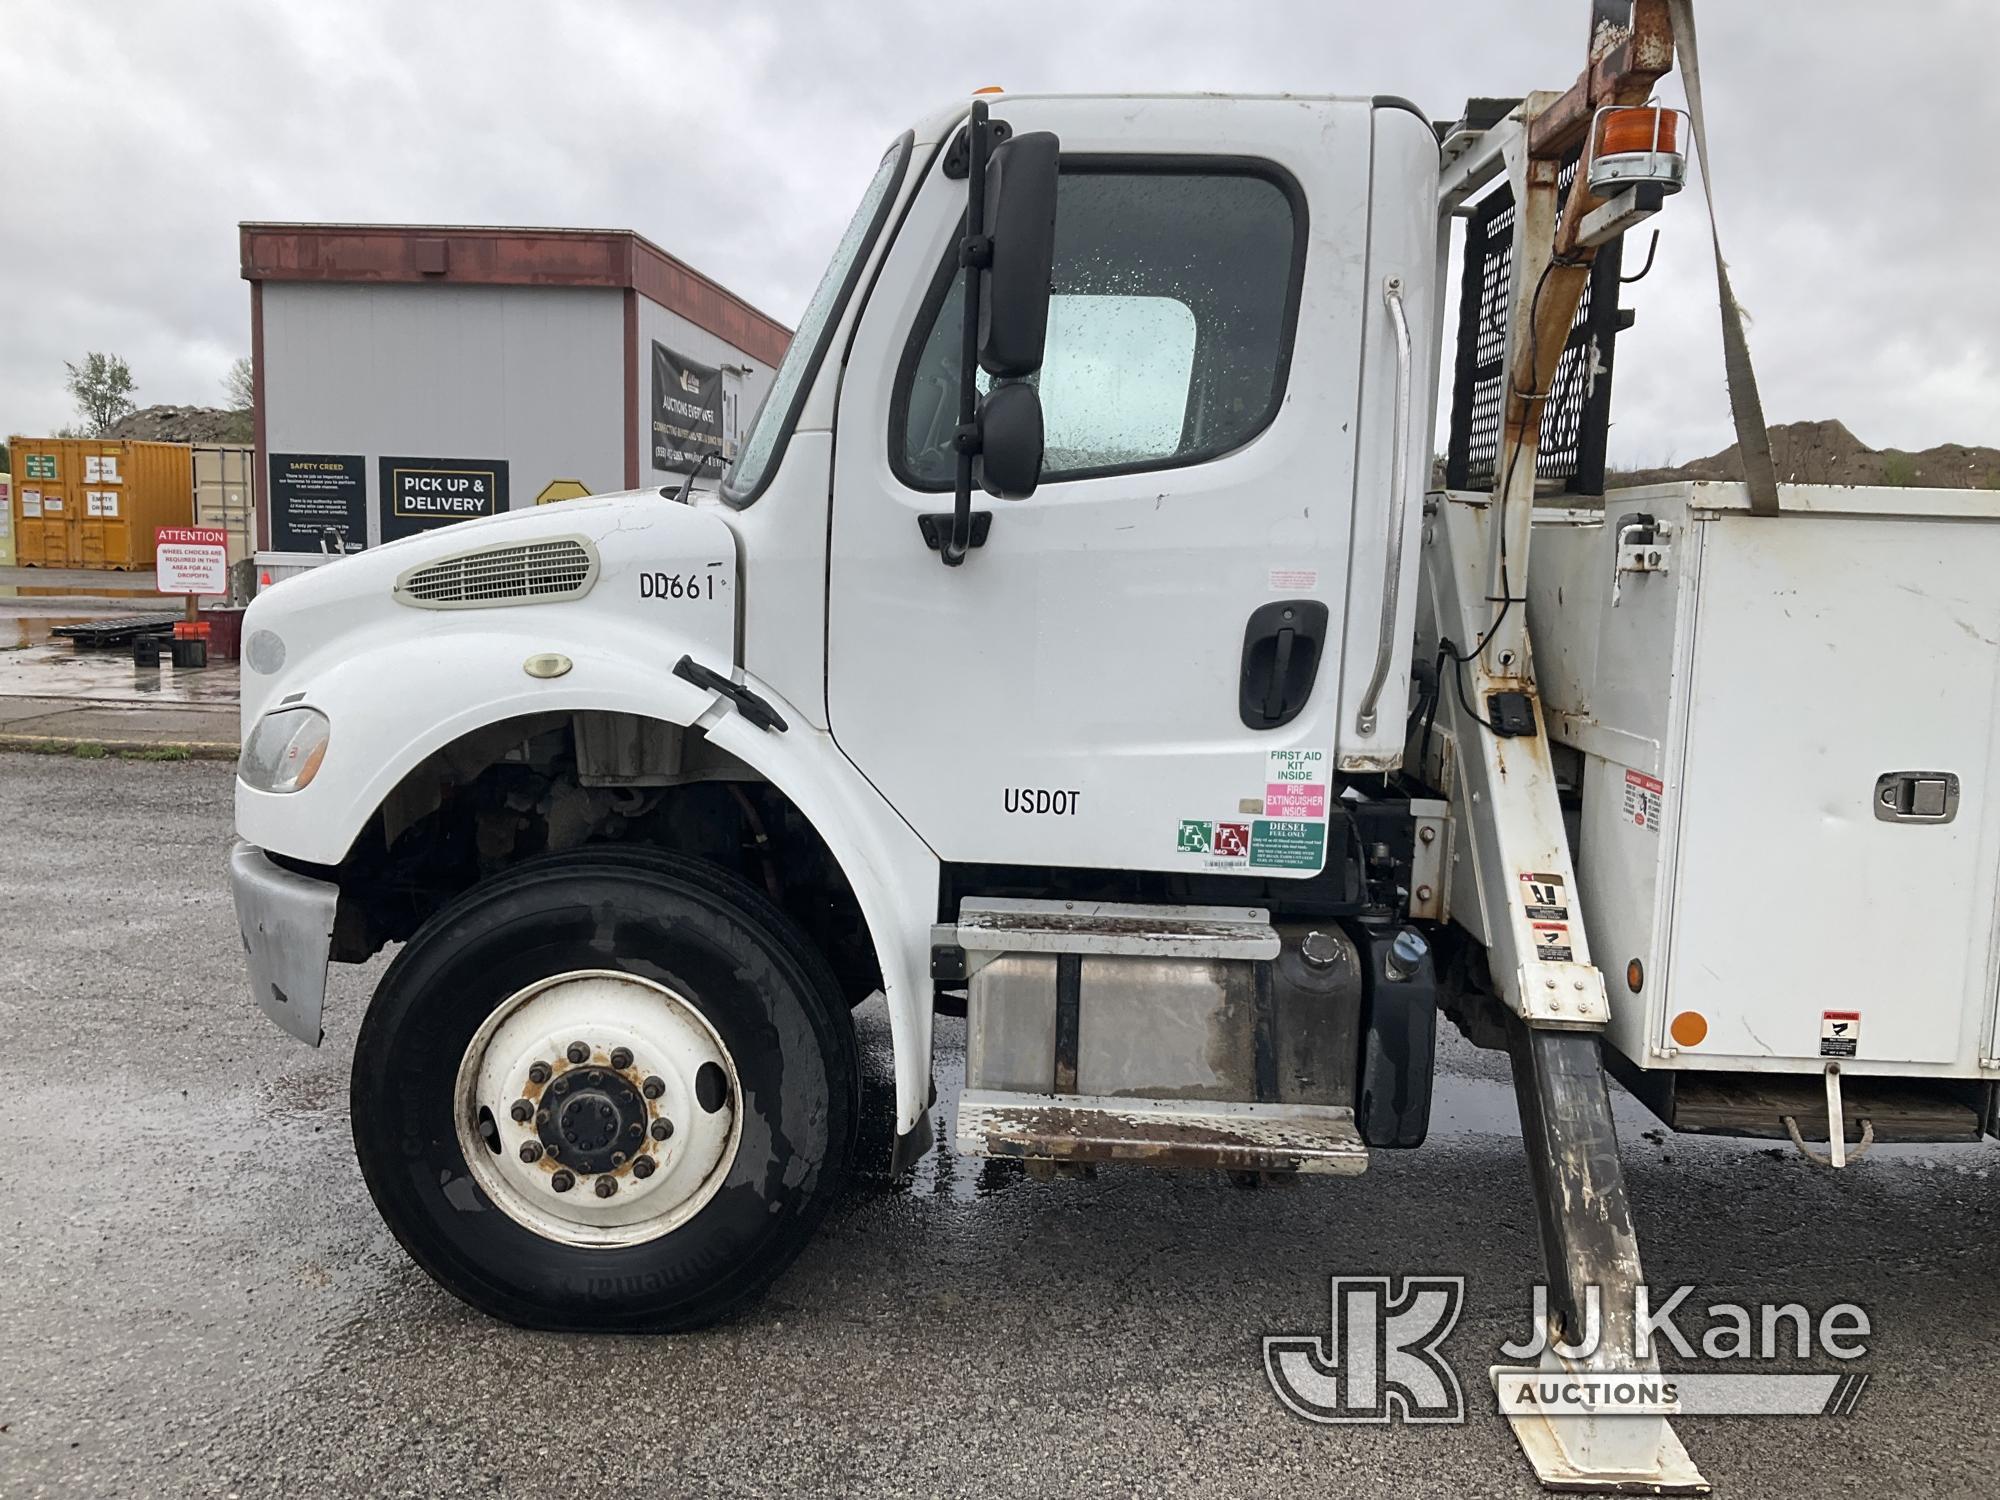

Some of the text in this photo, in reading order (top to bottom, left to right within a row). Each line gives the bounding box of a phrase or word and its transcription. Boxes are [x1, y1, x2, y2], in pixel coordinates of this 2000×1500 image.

[663, 395, 688, 417] AUCTIONS
[319, 463, 344, 471] CREED
[404, 477, 484, 492] PICK UP &
[404, 496, 485, 511] DELIVERY
[158, 530, 224, 541] ATTENTION
[1270, 750, 1322, 761] FIRST AID
[1287, 761, 1304, 770] KIT
[1277, 771, 1313, 780] INSIDE
[1286, 784, 1304, 795] FIRE
[1004, 788, 1080, 815] USDOT
[1267, 795, 1323, 806] EXTINGUISHER
[1282, 807, 1307, 816] INSIDE
[1269, 822, 1308, 832] DIESEL
